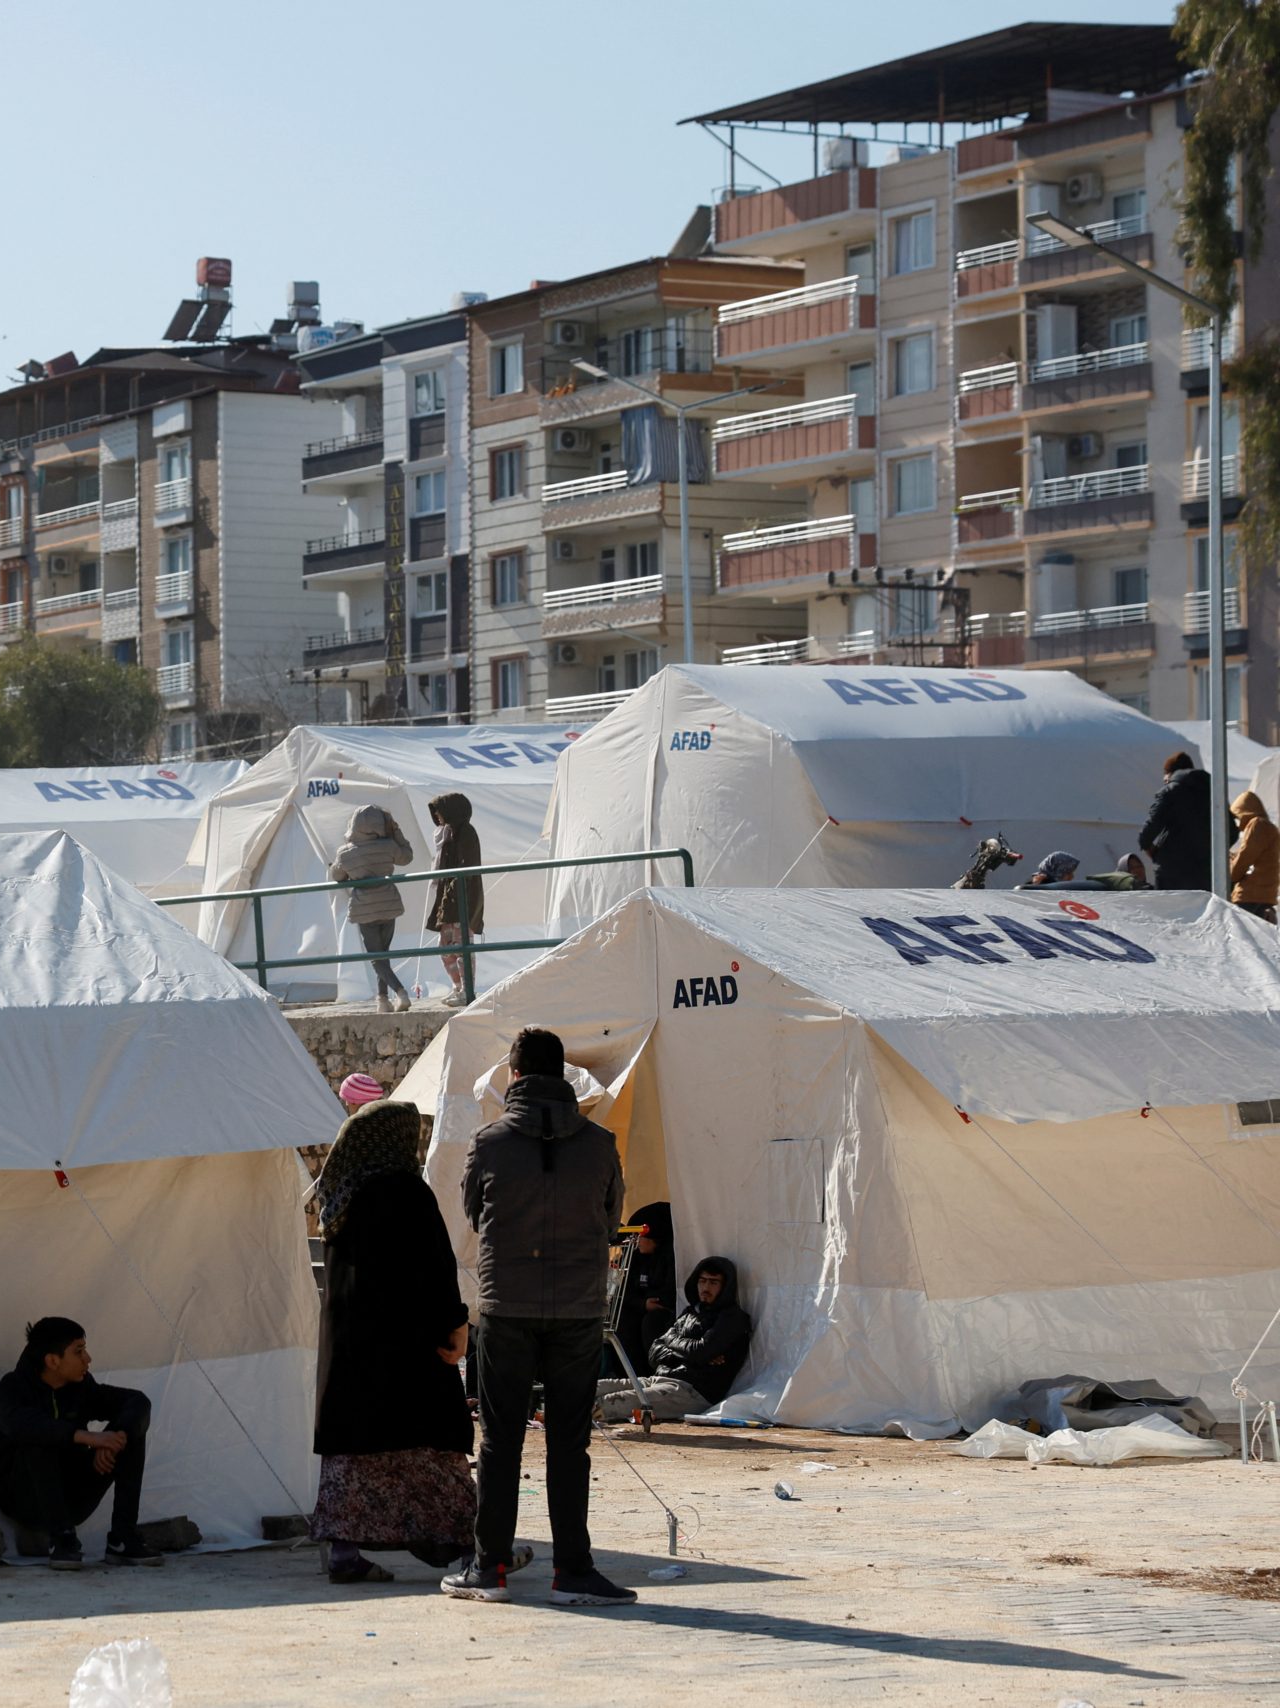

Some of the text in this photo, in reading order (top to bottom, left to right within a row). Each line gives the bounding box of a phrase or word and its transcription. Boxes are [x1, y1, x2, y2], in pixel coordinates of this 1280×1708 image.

[823, 678, 1027, 706] AFAD
[669, 731, 712, 751] AFAD
[33, 777, 196, 803] AFAD
[307, 778, 340, 799] AFAD
[861, 914, 1157, 966] AFAD
[673, 976, 739, 1009] AFAD
